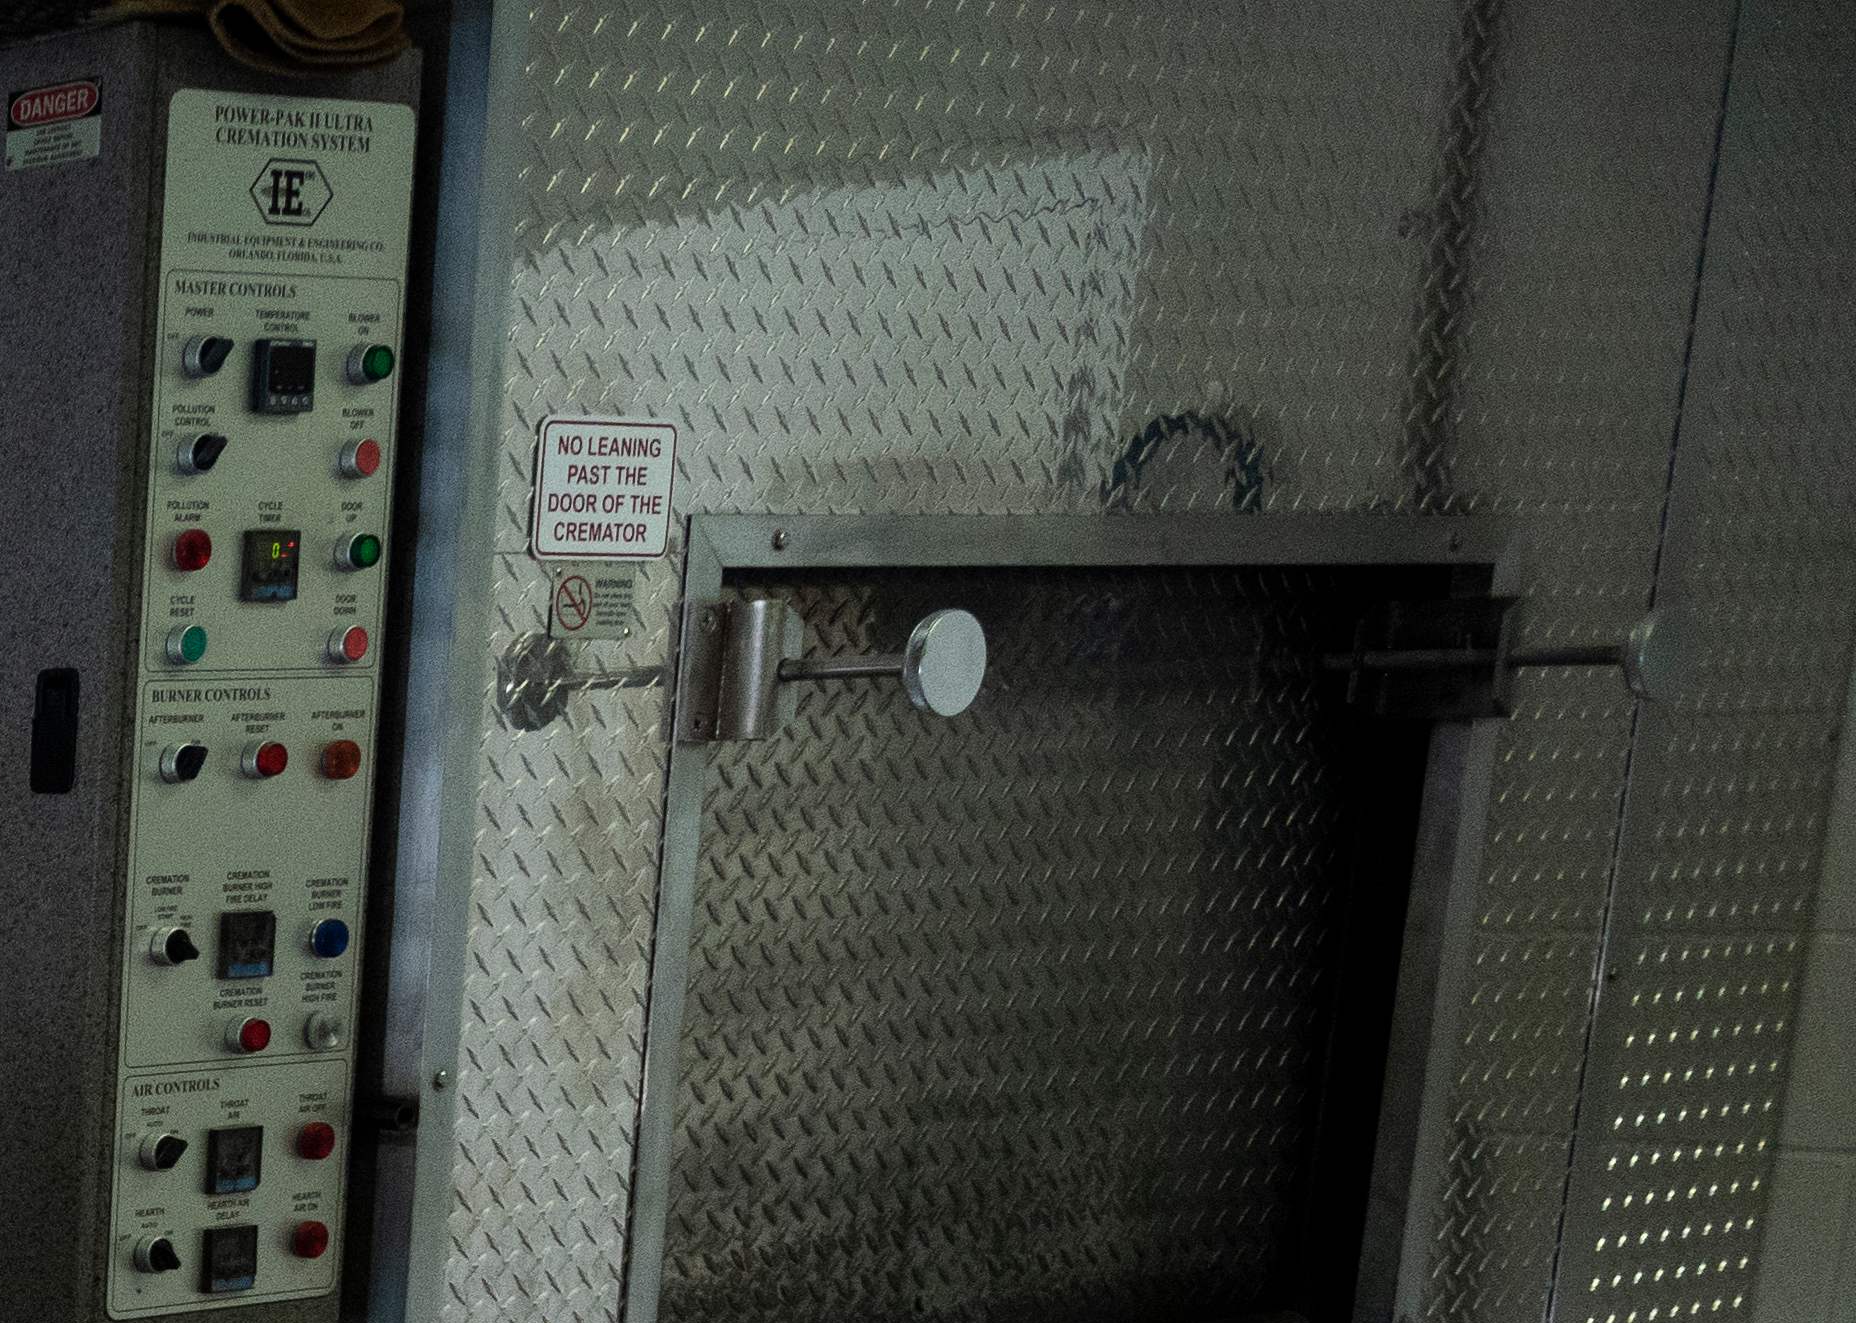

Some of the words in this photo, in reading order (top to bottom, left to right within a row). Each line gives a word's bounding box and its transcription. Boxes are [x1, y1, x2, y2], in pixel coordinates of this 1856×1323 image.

[19, 88, 89, 121] DANGER
[215, 105, 305, 128] POWER-PAK
[324, 113, 373, 132] ULTRA
[216, 127, 308, 149] CREMATION
[311, 134, 370, 153] SYSTEM
[188, 232, 241, 246] INDUSTRIAL
[244, 235, 296, 249] EQUIPMENT
[307, 237, 367, 251] ENGINEERING
[174, 279, 229, 297] MASTER
[230, 281, 297, 299] CONTROLS
[185, 306, 214, 317] POWER
[256, 309, 310, 321] TEMPERATURE
[348, 312, 380, 323] BLOWER
[264, 322, 299, 333] CONTROL
[172, 404, 215, 415] POLLUTION
[342, 408, 374, 418] BLOWER
[174, 417, 211, 427] CONTROL
[558, 435, 583, 456] NO
[587, 436, 662, 458] LEANING
[567, 464, 611, 486] PAST
[616, 465, 648, 486] THE
[167, 501, 209, 511] POLLUTION
[258, 501, 283, 511] CYCLE
[341, 502, 363, 512] DOOR
[547, 493, 597, 513] DOOR
[602, 494, 626, 514] OF
[630, 495, 663, 515] THE
[174, 513, 201, 523] ALARM
[259, 513, 282, 523] TIMER
[553, 522, 647, 543] CREMATOR
[272, 542, 281, 559] 0
[595, 578, 633, 589] WARNING
[170, 595, 195, 605] CYCLE
[336, 594, 357, 604] DOOR
[170, 607, 195, 617] RESET
[333, 606, 357, 616] DOWN
[152, 688, 202, 703] BURNER
[204, 687, 271, 702] CONTROLS
[148, 714, 204, 725] AFTERBURNER
[231, 711, 286, 723] AFTERBURNER
[311, 709, 365, 721] AFTERBURNER
[245, 724, 269, 734] RESET
[146, 874, 190, 885] CREMATION
[226, 870, 270, 881] CREMATION
[222, 882, 254, 893] BURNER
[255, 881, 273, 891] HIGH
[305, 878, 349, 889] CREMATION
[151, 886, 183, 897] BURNER
[311, 889, 342, 900] BURNER
[225, 894, 243, 904] FIRE
[244, 893, 268, 903] DELAY
[308, 902, 325, 912] LOW
[326, 901, 343, 911] FIRE
[300, 970, 343, 981] CREMATION
[219, 987, 263, 998] CREMATION
[305, 982, 335, 992] BURNER
[302, 993, 319, 1003] HIGH
[320, 993, 337, 1003] FIRE
[213, 999, 242, 1010] BURNER
[243, 998, 268, 1008] RESET
[131, 1082, 152, 1098] AIR
[155, 1078, 220, 1096] CONTROLS
[299, 1092, 328, 1103] THROAT
[220, 1099, 249, 1110] THROAT
[141, 1106, 170, 1116] THROAT
[292, 1191, 322, 1201] HEARTH
[135, 1207, 165, 1218] HEARTH
[215, 1210, 241, 1220] DELAY
